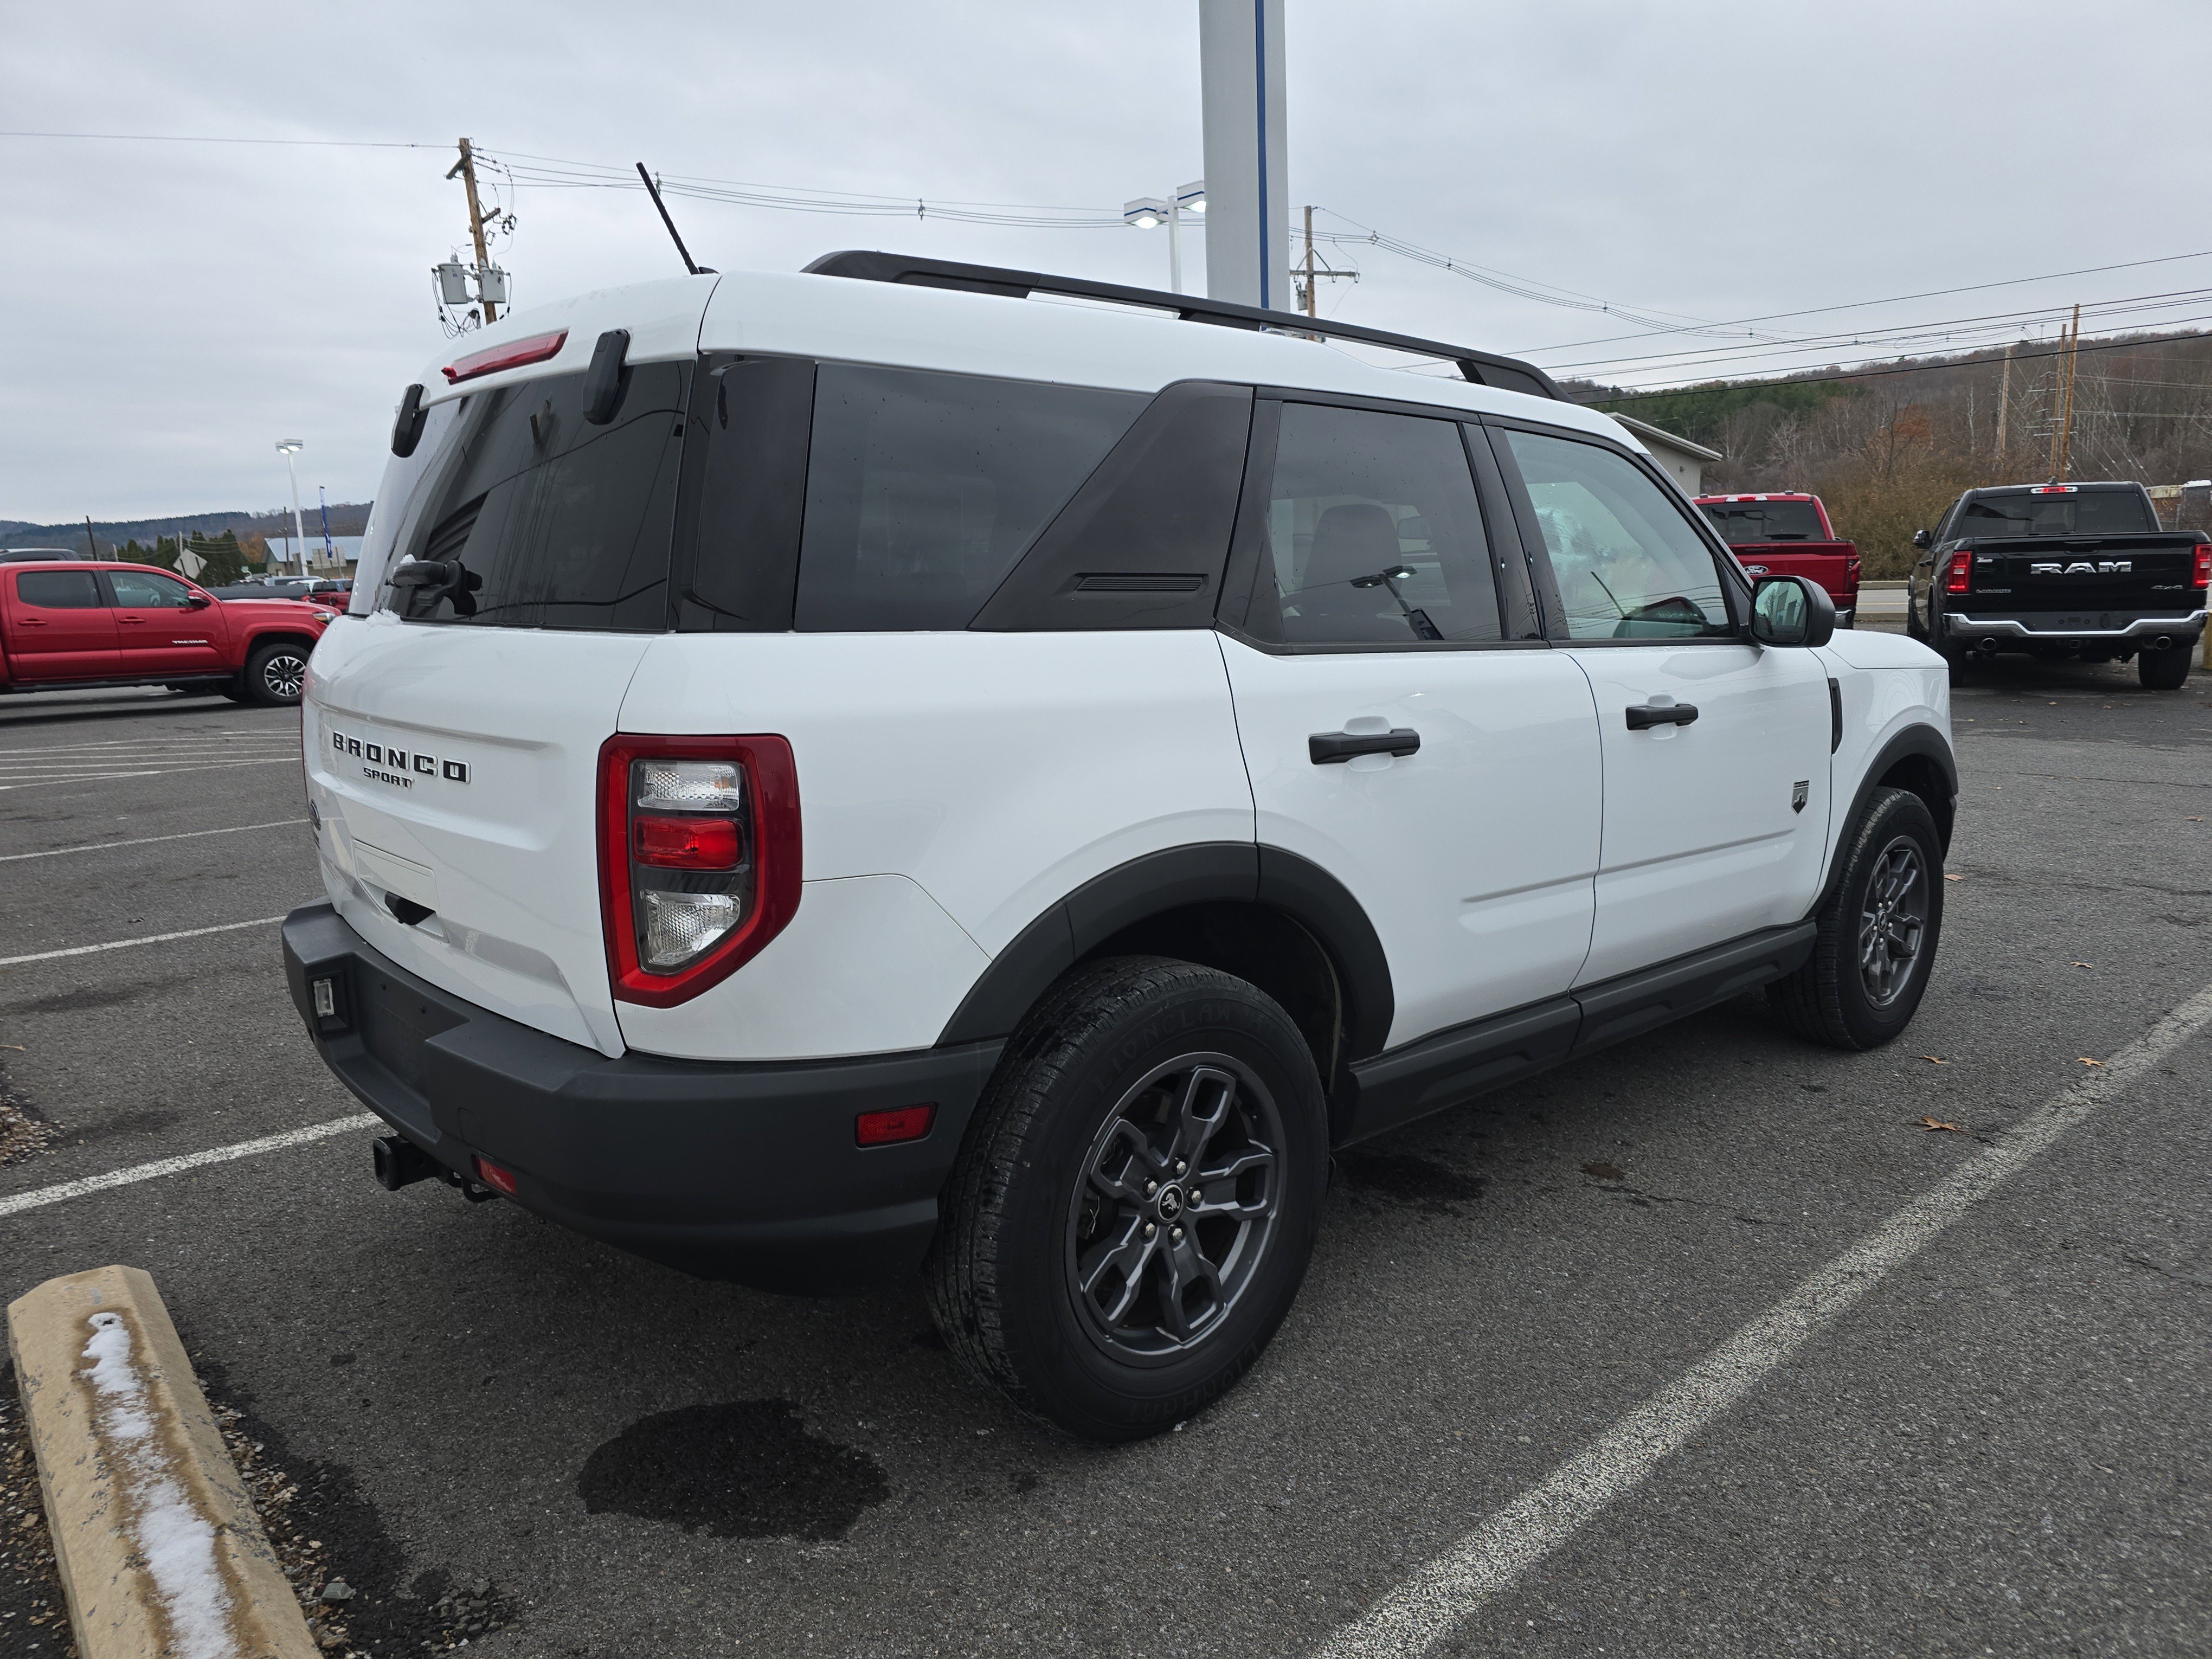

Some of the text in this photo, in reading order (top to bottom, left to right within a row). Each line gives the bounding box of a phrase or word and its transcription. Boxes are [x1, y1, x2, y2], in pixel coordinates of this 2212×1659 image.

[2030, 561, 2132, 575] RAM
[333, 731, 470, 783] BRONCO
[364, 767, 414, 788] SPORT
[1092, 1003, 1230, 1096] LIONCLAW
